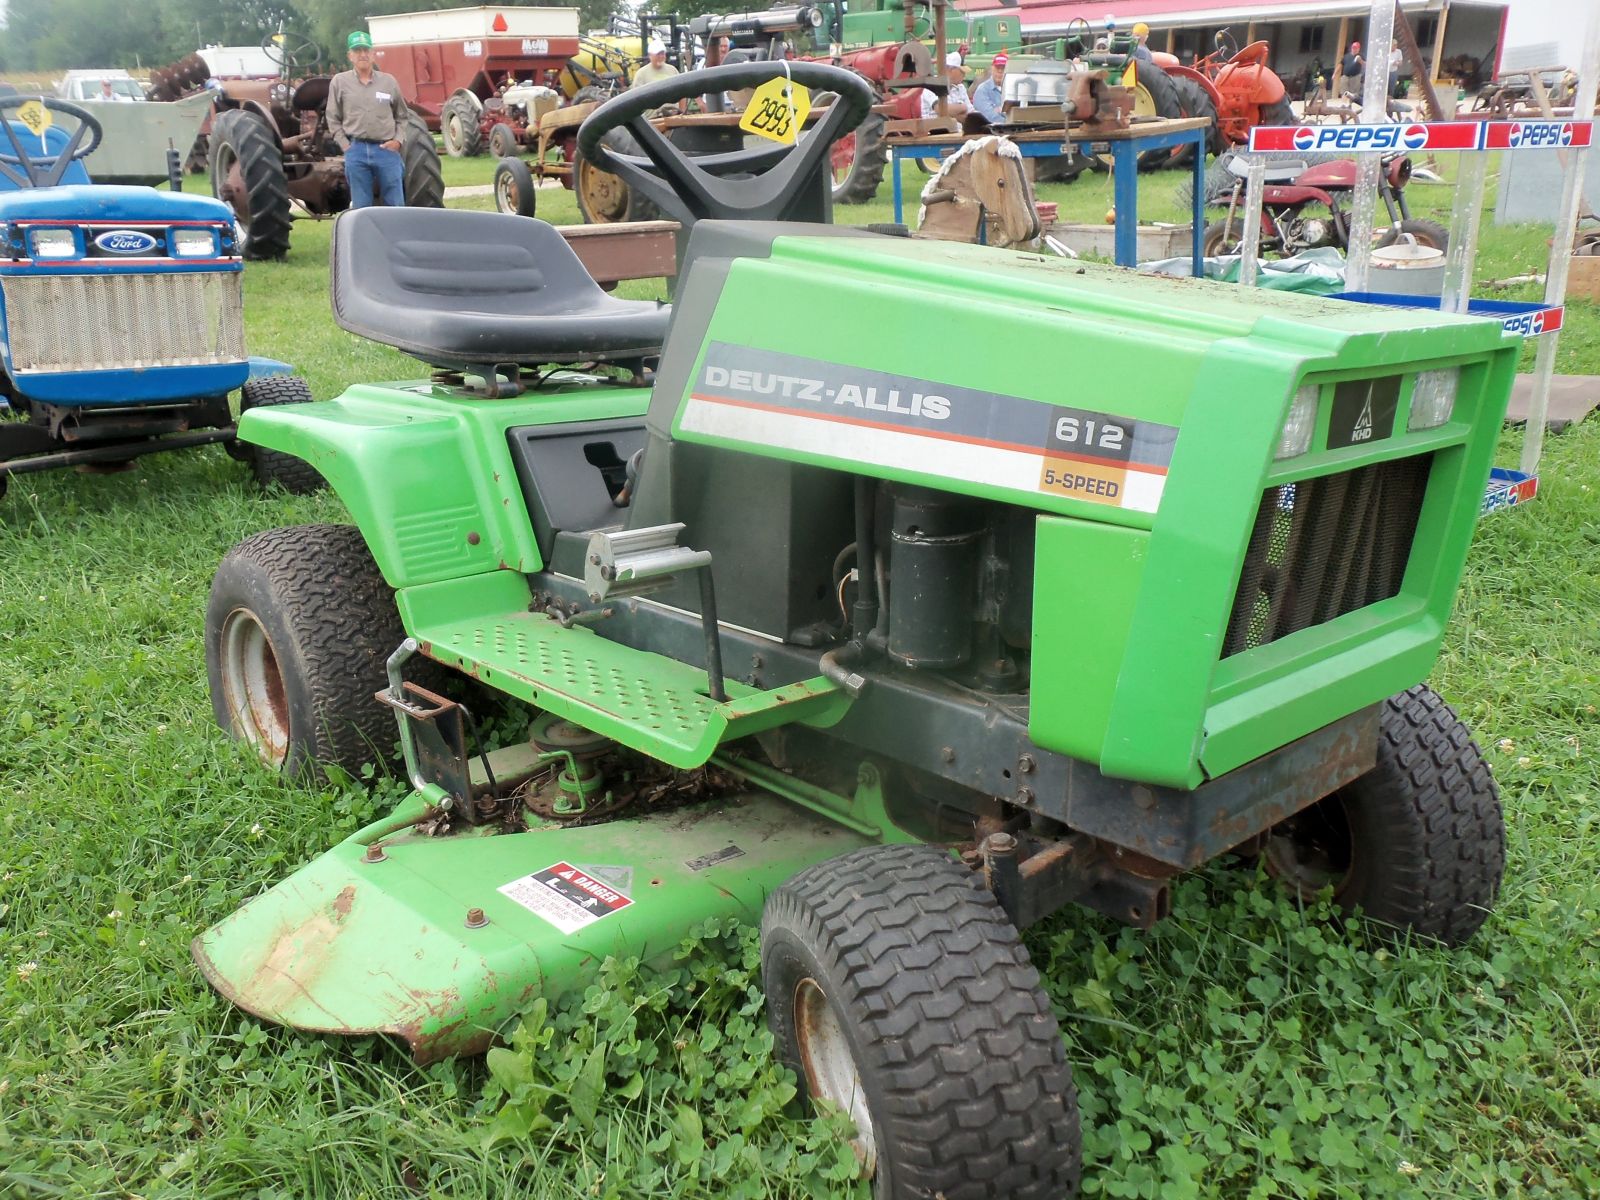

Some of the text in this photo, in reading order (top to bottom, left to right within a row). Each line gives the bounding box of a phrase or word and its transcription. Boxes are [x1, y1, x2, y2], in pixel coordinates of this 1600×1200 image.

[1316, 127, 1401, 149] PEPSI
[1521, 124, 1562, 146] PEPSI
[111, 234, 142, 248] Ford
[1502, 315, 1533, 334] EPSI
[705, 366, 951, 420] DEUTZ-ALLIS
[1055, 417, 1124, 450] 612
[1352, 428, 1371, 441] KHD
[1045, 469, 1119, 498] 5-SPEED
[573, 876, 619, 903] DANGER
